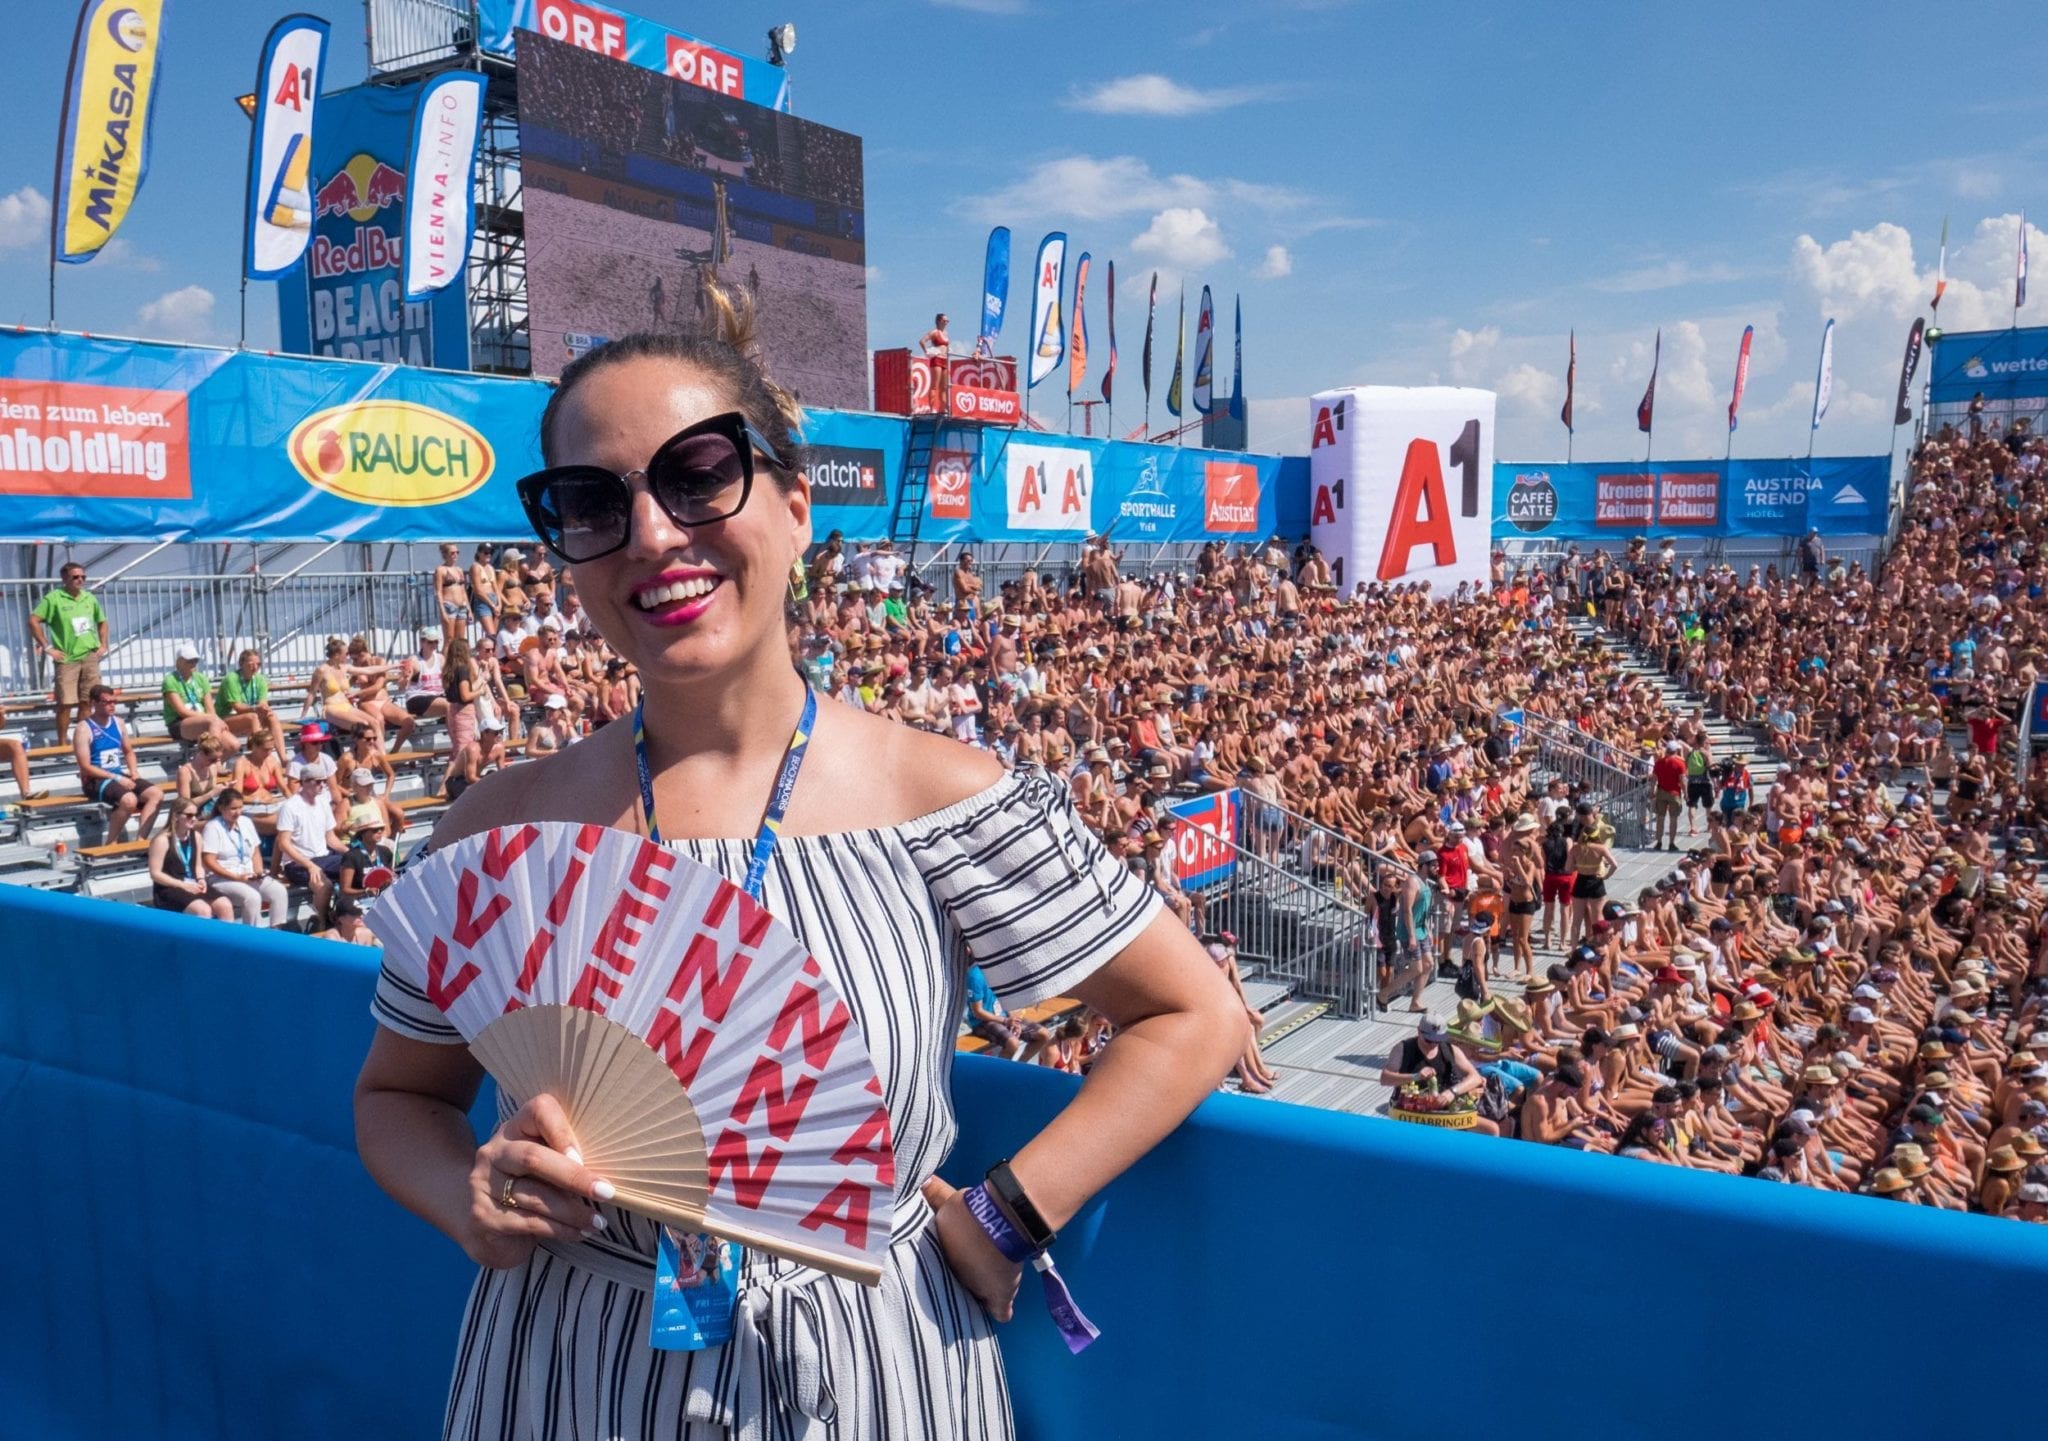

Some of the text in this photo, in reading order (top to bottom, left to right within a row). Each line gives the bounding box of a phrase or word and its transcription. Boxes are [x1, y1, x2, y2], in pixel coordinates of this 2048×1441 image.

[541, 5, 621, 55] ORF
[672, 48, 739, 95] ORF
[274, 62, 312, 112] A1
[429, 94, 458, 278] VIENNA.INFO
[312, 227, 365, 278] Red
[1041, 262, 1058, 289] A1
[314, 279, 426, 341] BEACH
[46, 405, 98, 424] zum
[103, 404, 171, 427] leben.
[978, 396, 1015, 414] ESKIMO
[1311, 400, 1345, 450] A1
[349, 431, 469, 478] RAUCH
[1018, 461, 1087, 514] A1 A1
[1511, 489, 1553, 504] CAFFÈ
[1599, 482, 1654, 499] Kronen
[1661, 481, 1716, 498] Kronen
[1744, 477, 1823, 491] AUSTRIA
[937, 493, 966, 506] ESKIMO
[1120, 502, 1176, 518] SPORTHALLE
[1209, 499, 1256, 523] Austrian
[1312, 478, 1345, 527] A1
[1377, 418, 1481, 582] A1
[1511, 504, 1553, 517] LATTE
[1599, 501, 1652, 519] Zeitung
[1661, 501, 1715, 518] Zeitung
[1744, 492, 1806, 506] TREND
[1179, 822, 1232, 865] ORF
[964, 1186, 1013, 1241] FRIDAY
